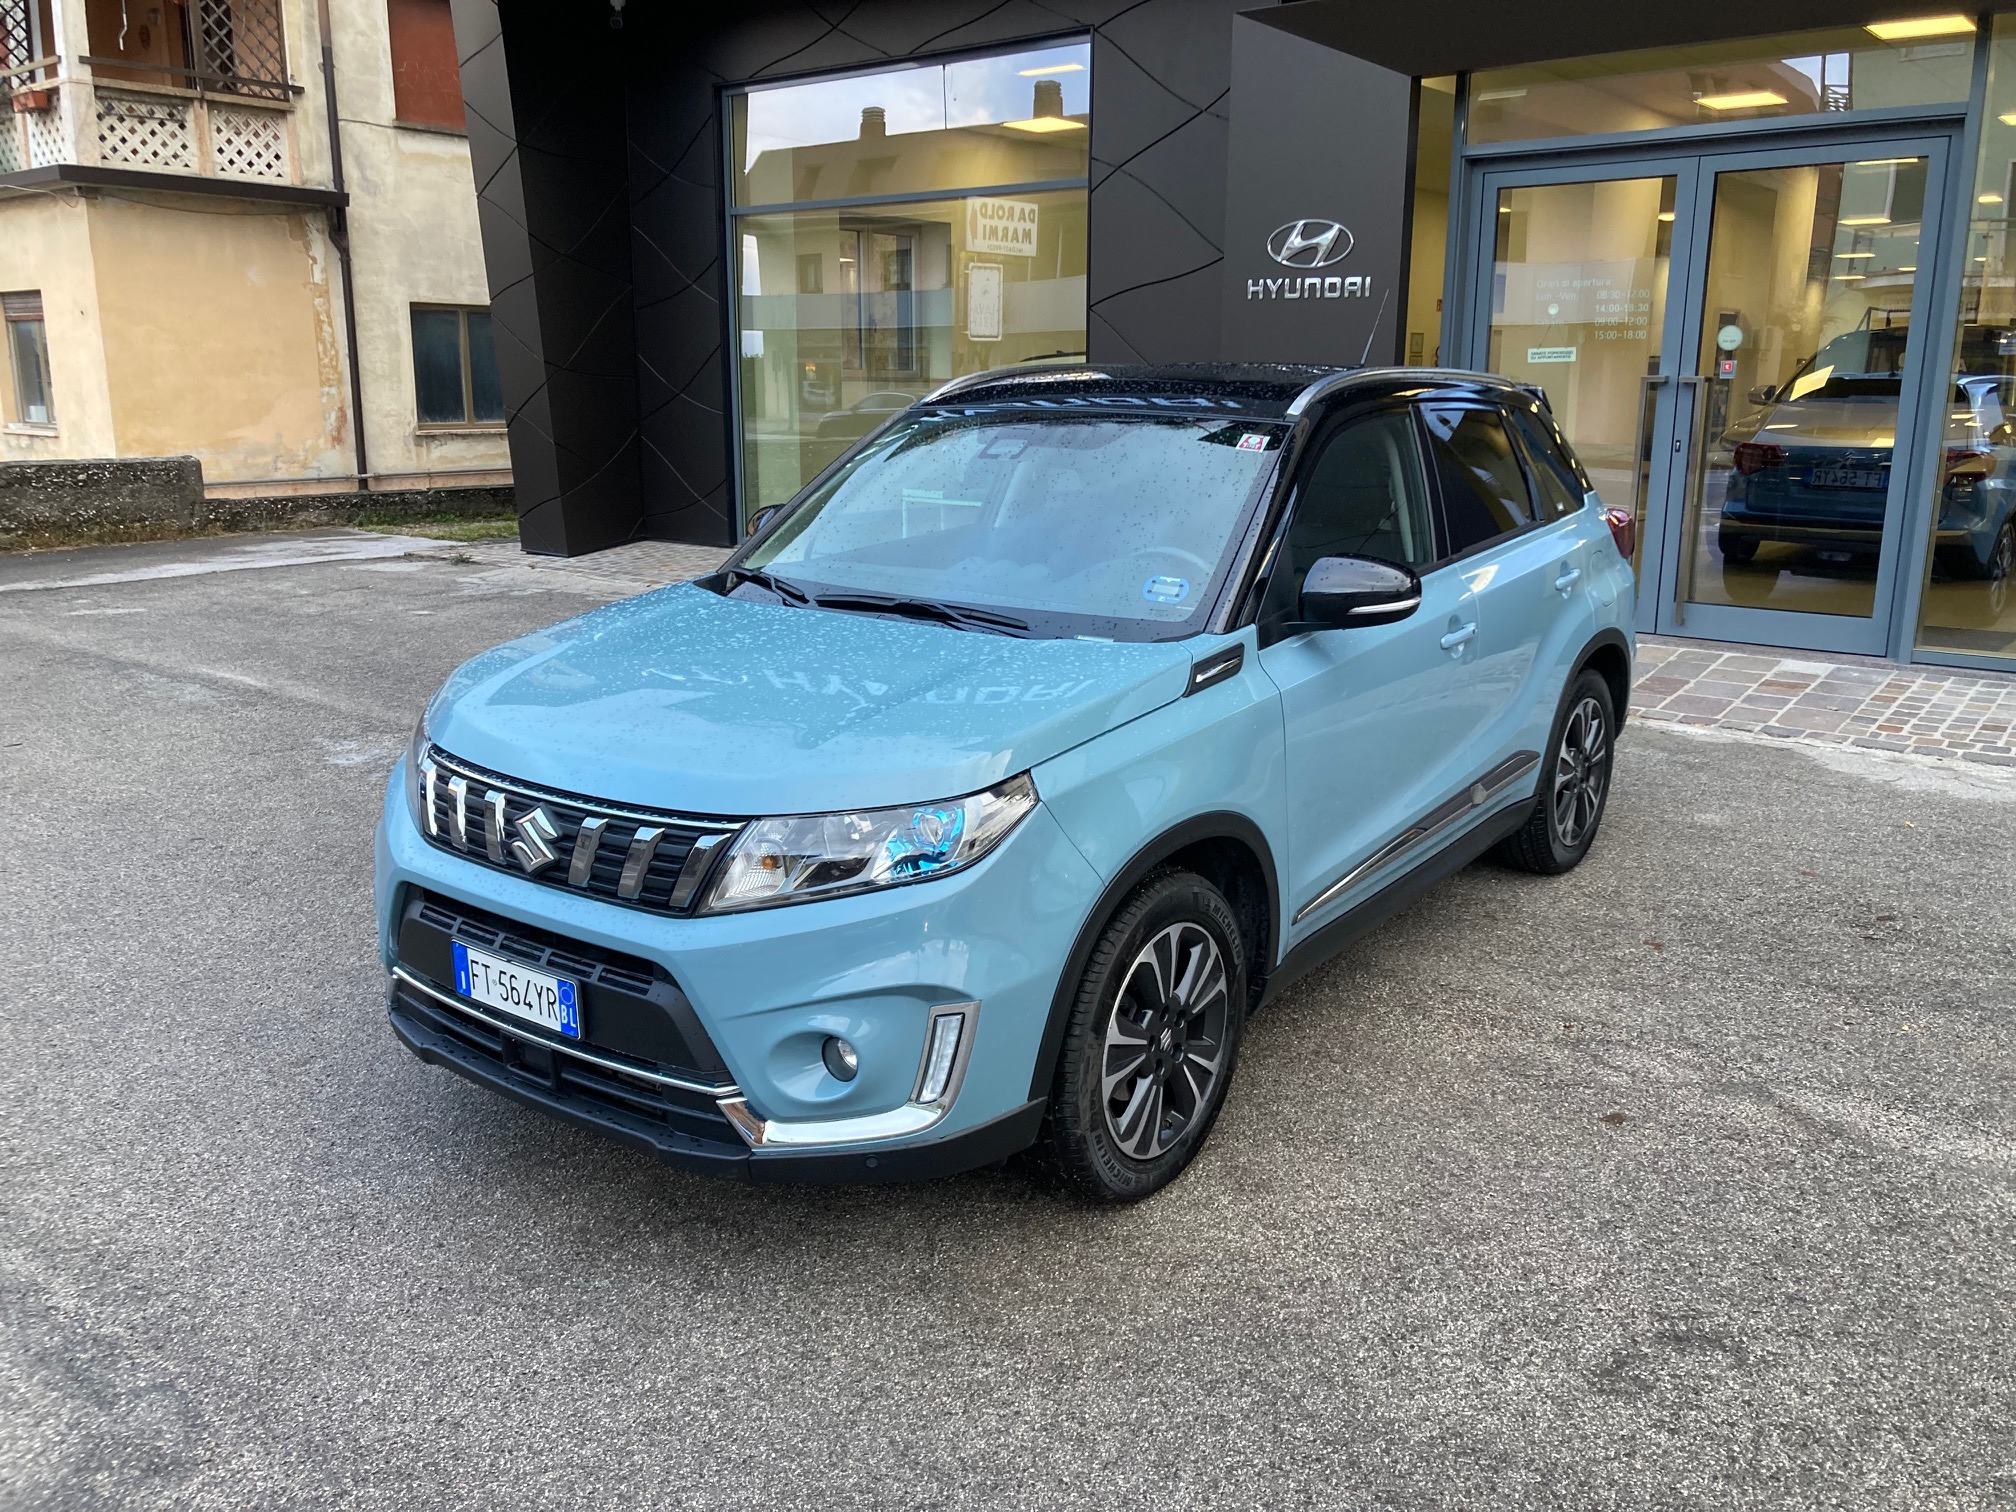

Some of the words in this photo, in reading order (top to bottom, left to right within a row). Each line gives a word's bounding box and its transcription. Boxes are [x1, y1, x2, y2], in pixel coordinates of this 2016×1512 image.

[1247, 276, 1371, 300] HYUNDAI
[1594, 330, 1647, 340] 15:00-18:00
[1212, 903, 1243, 960] MICHELIN
[469, 958, 491, 995] FT
[498, 970, 559, 1022] 564YR
[560, 1004, 577, 1028] BL
[1094, 1132, 1134, 1187] MICHELIN
